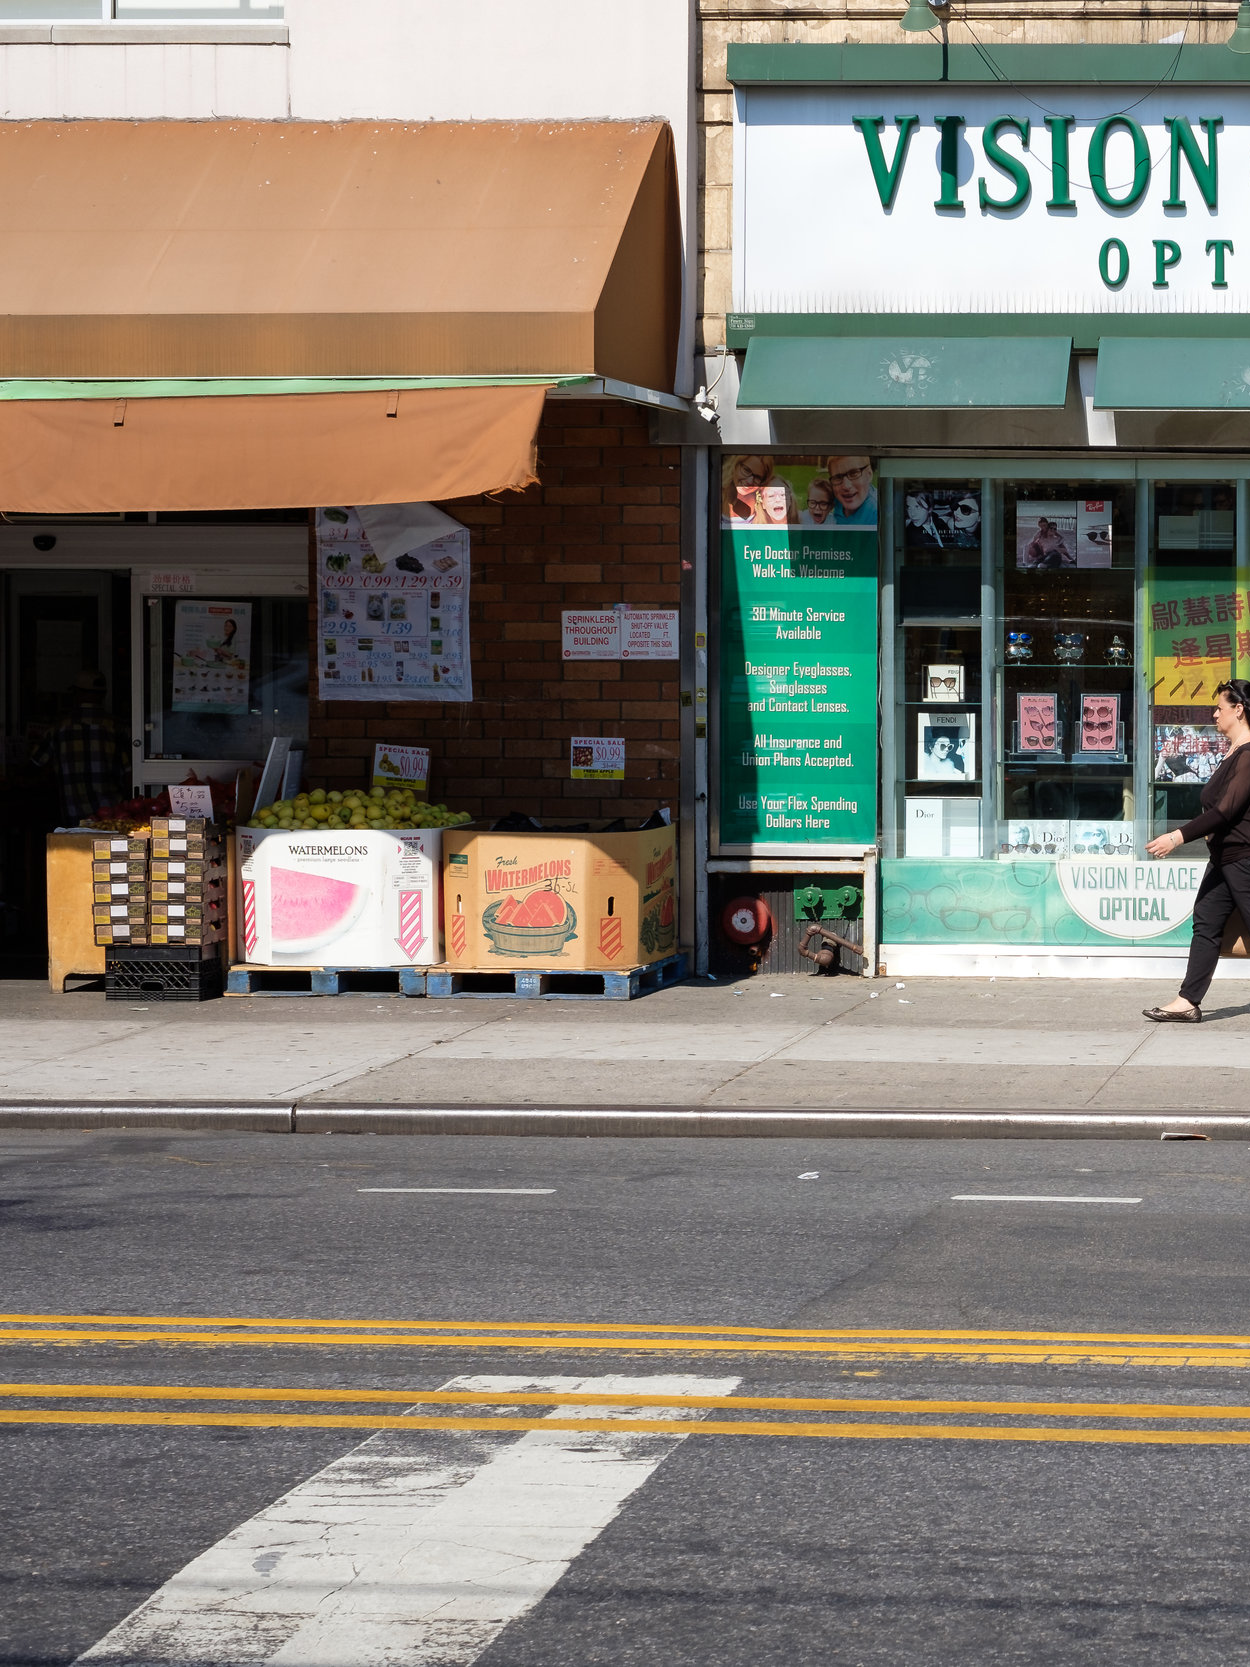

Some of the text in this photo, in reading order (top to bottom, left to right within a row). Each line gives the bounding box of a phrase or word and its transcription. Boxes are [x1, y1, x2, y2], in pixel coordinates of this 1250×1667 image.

[852, 114, 1224, 212] VISION
[744, 546, 854, 562] Eye Doctor Premises,
[752, 564, 845, 578] Walk-Ins Welcome
[567, 615, 615, 624] SPRINKLERS
[752, 607, 845, 622] 30 Minute Service
[565, 626, 618, 635] THROUGHOUT
[631, 622, 668, 630] SHUT-OFF VALVE
[776, 626, 821, 640] Available
[573, 637, 609, 646] BUILDING
[629, 631, 651, 639] LOCATED
[627, 640, 650, 648] OPPOSITE
[650, 640, 660, 648] THIS
[745, 662, 852, 679] Designer Eyeglasses,
[769, 680, 827, 696] Sunglasses
[748, 698, 850, 713] and Contact Lenses.
[936, 716, 957, 724] FENDI
[754, 734, 842, 749] All Insurance and
[379, 746, 409, 754] SPECIAL
[596, 747, 620, 761] $0.99
[400, 756, 423, 777] $0.99
[742, 752, 854, 769] Union Plans Accepted.
[738, 796, 858, 813] Use Your Flex Spending
[765, 814, 830, 828] Dollars Here
[916, 809, 934, 819] Dior
[1043, 832, 1066, 843] Dior
[289, 846, 368, 856] WATERMELONS
[495, 856, 518, 868] Fresh
[1071, 867, 1198, 890] VISION PALACE
[1099, 898, 1170, 921] OPTICAL
